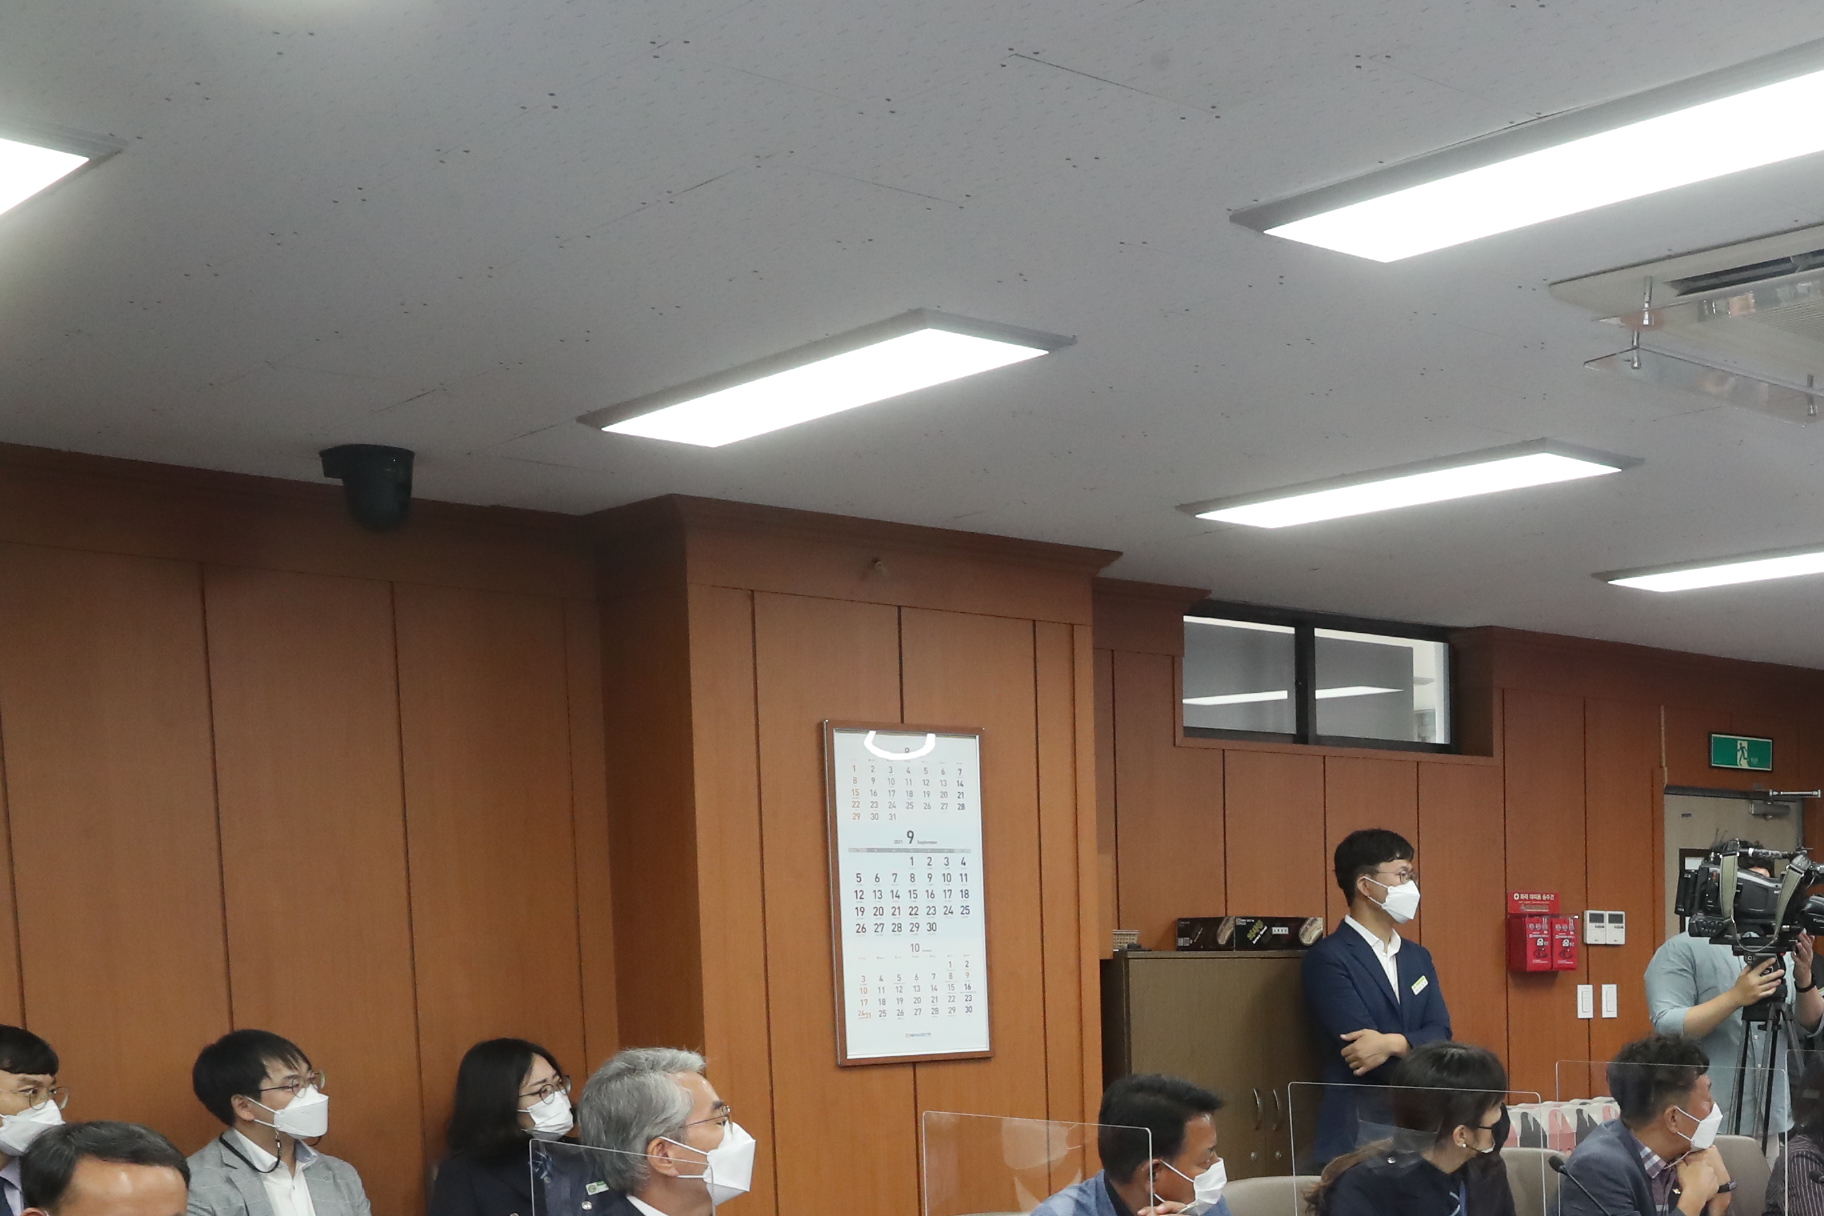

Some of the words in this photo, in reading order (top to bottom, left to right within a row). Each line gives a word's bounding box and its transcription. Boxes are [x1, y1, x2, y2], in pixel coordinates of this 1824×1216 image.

[888, 801, 896, 809] 24
[906, 830, 914, 844] 9
[909, 857, 914, 866] 1
[926, 857, 933, 866] 2
[943, 857, 950, 866] 3
[960, 857, 967, 866] 4
[855, 873, 862, 882] 5
[874, 873, 881, 882] 6
[891, 873, 898, 882] 7
[909, 873, 916, 882] 8
[927, 873, 933, 882] 9
[942, 873, 951, 882] 10
[960, 873, 967, 882] 11
[855, 890, 864, 899] 12
[873, 890, 882, 899] 13
[891, 890, 900, 899] 14
[908, 890, 917, 899] 15
[926, 890, 935, 899] 16
[943, 889, 952, 899] 17
[960, 889, 969, 898] 18
[855, 907, 865, 916] 19
[873, 907, 884, 916] 20
[891, 906, 900, 916] 21
[909, 906, 918, 915] 22
[926, 906, 936, 915] 23
[944, 906, 953, 915] 24
[961, 905, 970, 915] 25
[856, 924, 866, 933] 26
[874, 923, 884, 932] 27
[892, 923, 902, 932] 28
[910, 923, 920, 932] 29
[927, 922, 937, 931] 30
[910, 943, 920, 953] 10
